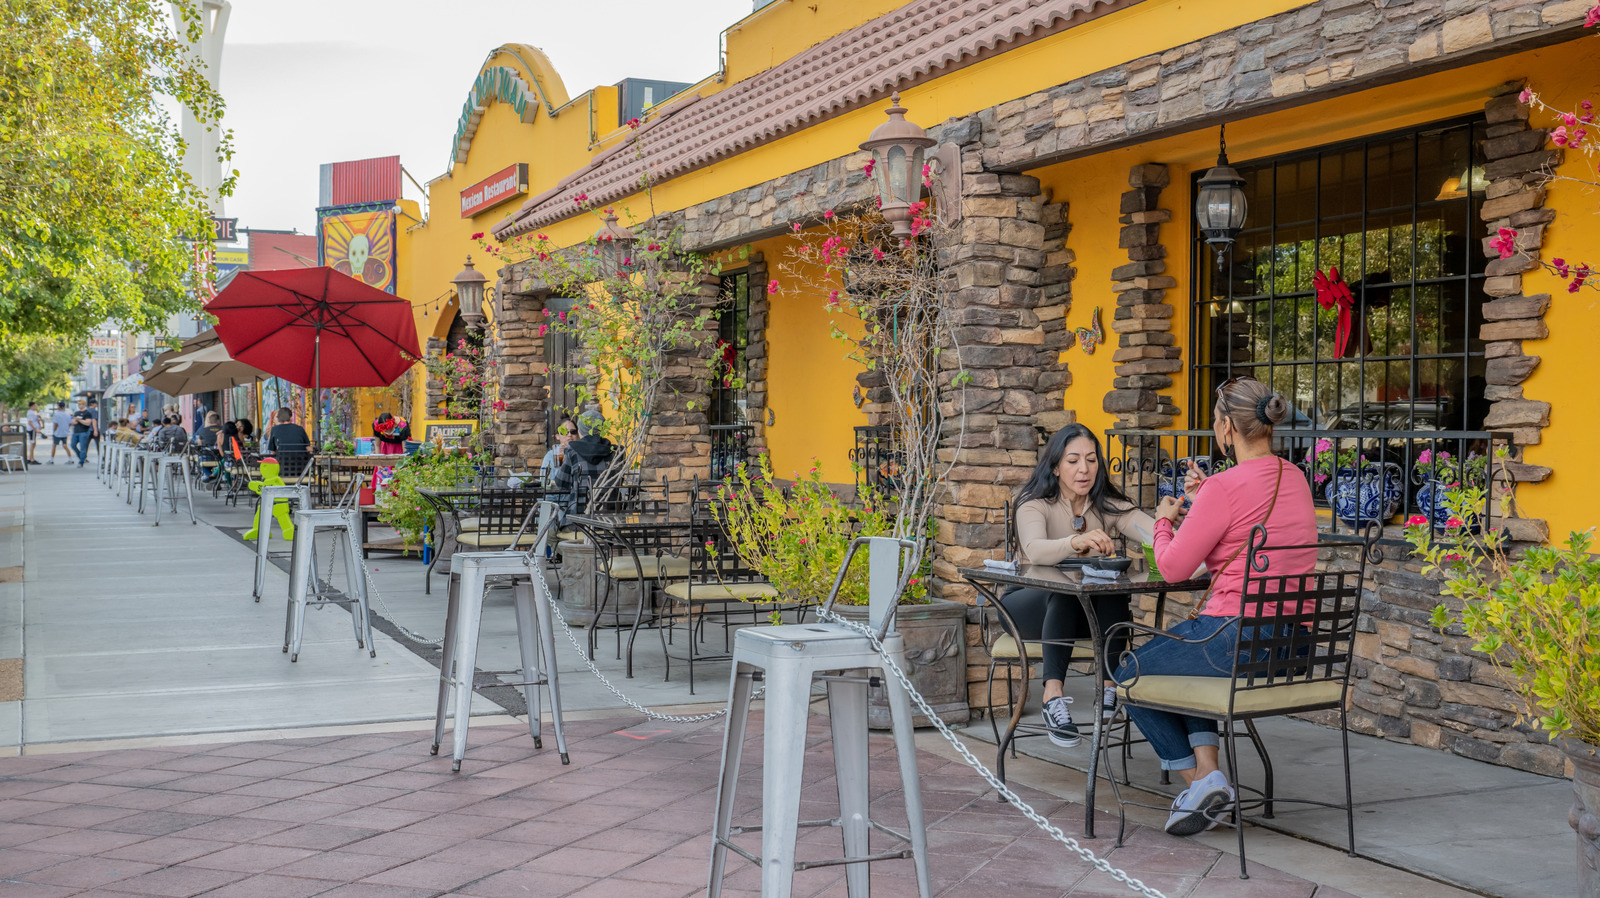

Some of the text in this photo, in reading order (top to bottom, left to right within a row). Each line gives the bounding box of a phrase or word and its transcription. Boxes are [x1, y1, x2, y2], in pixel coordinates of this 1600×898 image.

[475, 66, 496, 107] DON
[498, 66, 527, 123] JUAN
[462, 171, 516, 213] Mexican Restaurant
